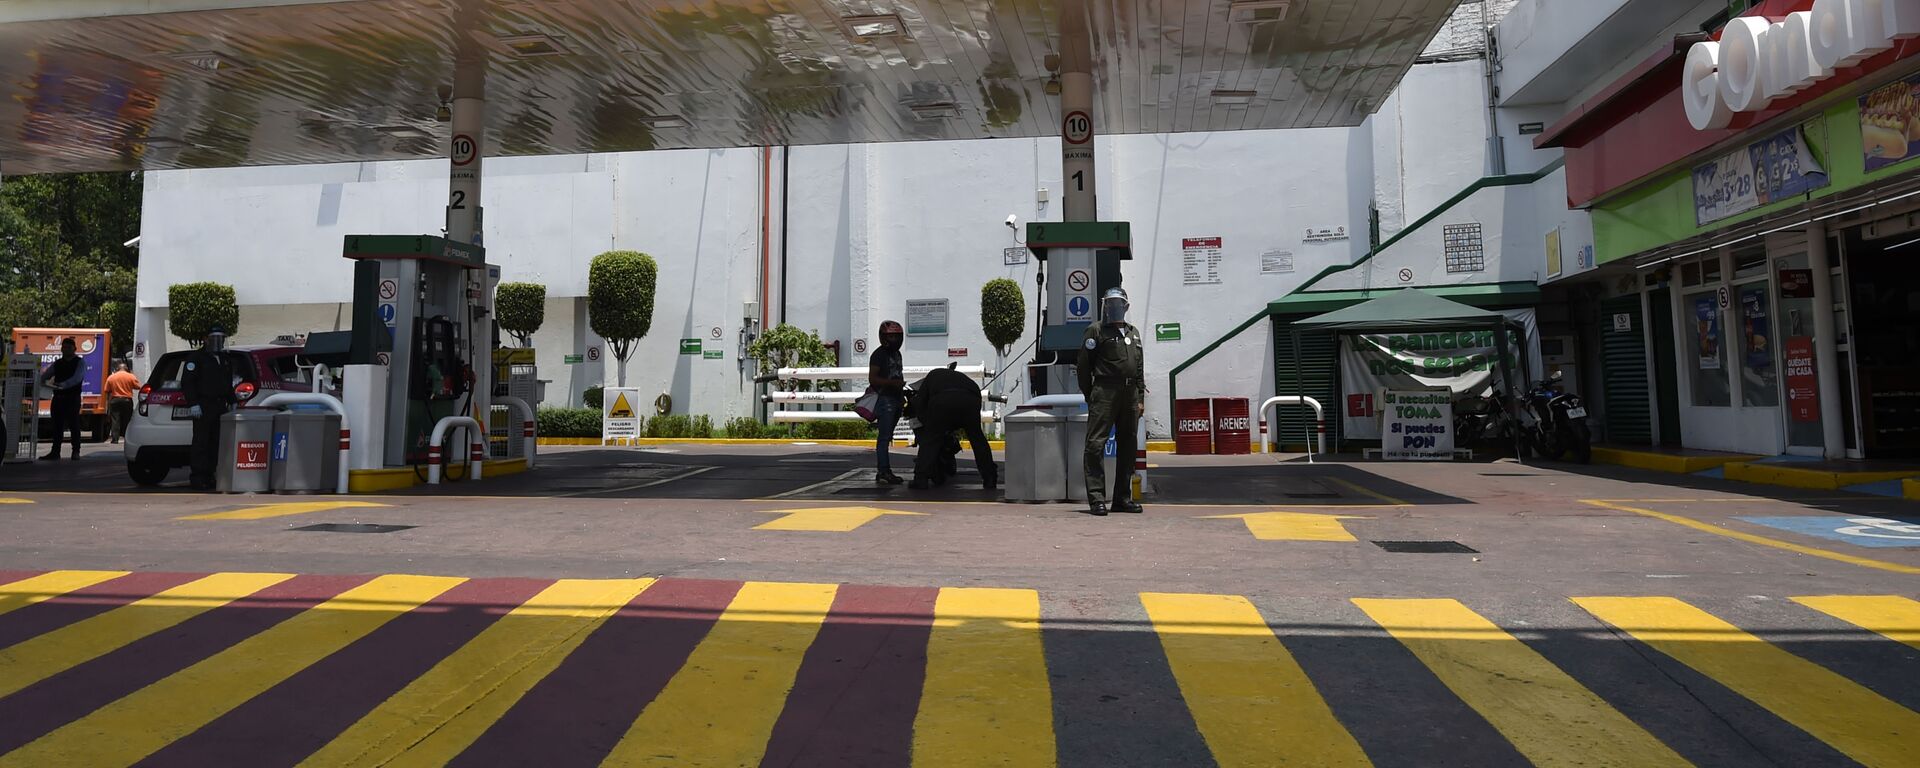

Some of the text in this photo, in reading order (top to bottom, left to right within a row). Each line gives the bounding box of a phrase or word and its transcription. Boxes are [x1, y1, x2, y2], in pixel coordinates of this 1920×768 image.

[1069, 118, 1087, 133] 10
[454, 141, 470, 155] 10
[1072, 170, 1083, 191] 1
[451, 190, 466, 210] 2
[1036, 225, 1045, 240] 2
[1113, 225, 1121, 240] 1
[352, 238, 359, 252] 4
[416, 238, 423, 252] 3
[1388, 330, 1519, 355] pandema
[1369, 358, 1416, 376] nos
[1788, 367, 1813, 376] EN CASA
[1347, 393, 1374, 417] El
[1385, 393, 1451, 404] Si necesitas
[1395, 406, 1443, 419] TOMA
[1179, 419, 1210, 432] ARENERO
[1391, 423, 1446, 436] Si puedes
[1403, 435, 1436, 449] PON
[236, 461, 267, 469] PELIGROSOS
